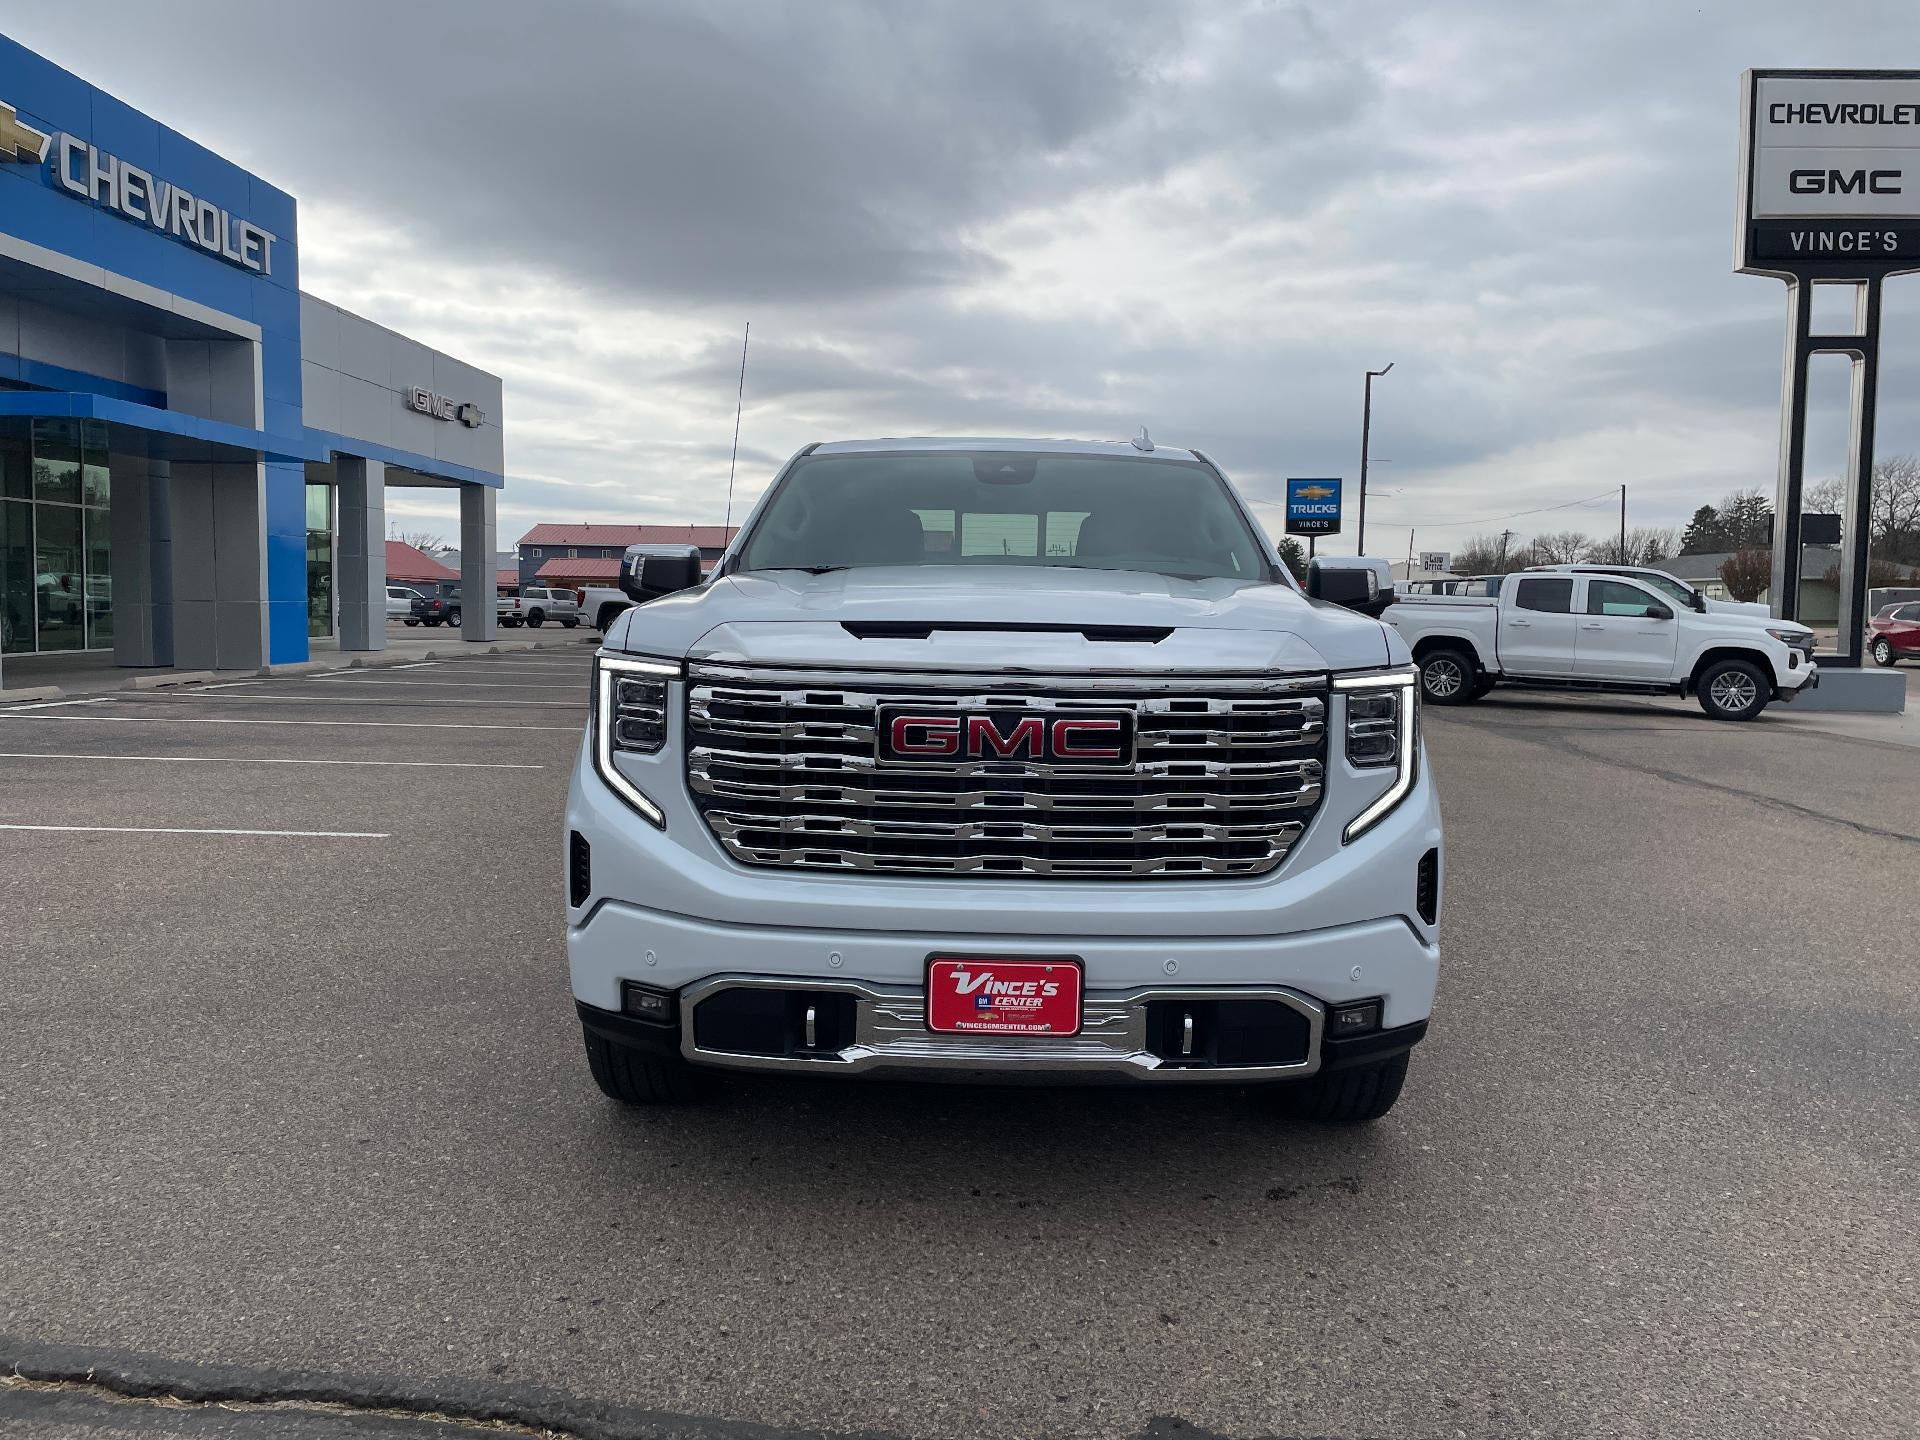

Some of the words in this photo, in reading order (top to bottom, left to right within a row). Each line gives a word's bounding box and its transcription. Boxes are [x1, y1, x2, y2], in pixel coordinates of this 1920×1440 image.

[1769, 103, 1920, 124] CHEVROLET
[1789, 169, 1902, 194] GMC
[55, 131, 277, 276] CHEVROLET
[1790, 231, 1898, 251] VINCE'S
[410, 386, 455, 421] GMC
[1291, 504, 1337, 514] TRUCKS
[1298, 520, 1329, 528] VINCE'S
[891, 716, 1121, 758] GMC
[995, 996, 1043, 1006] CENTER
